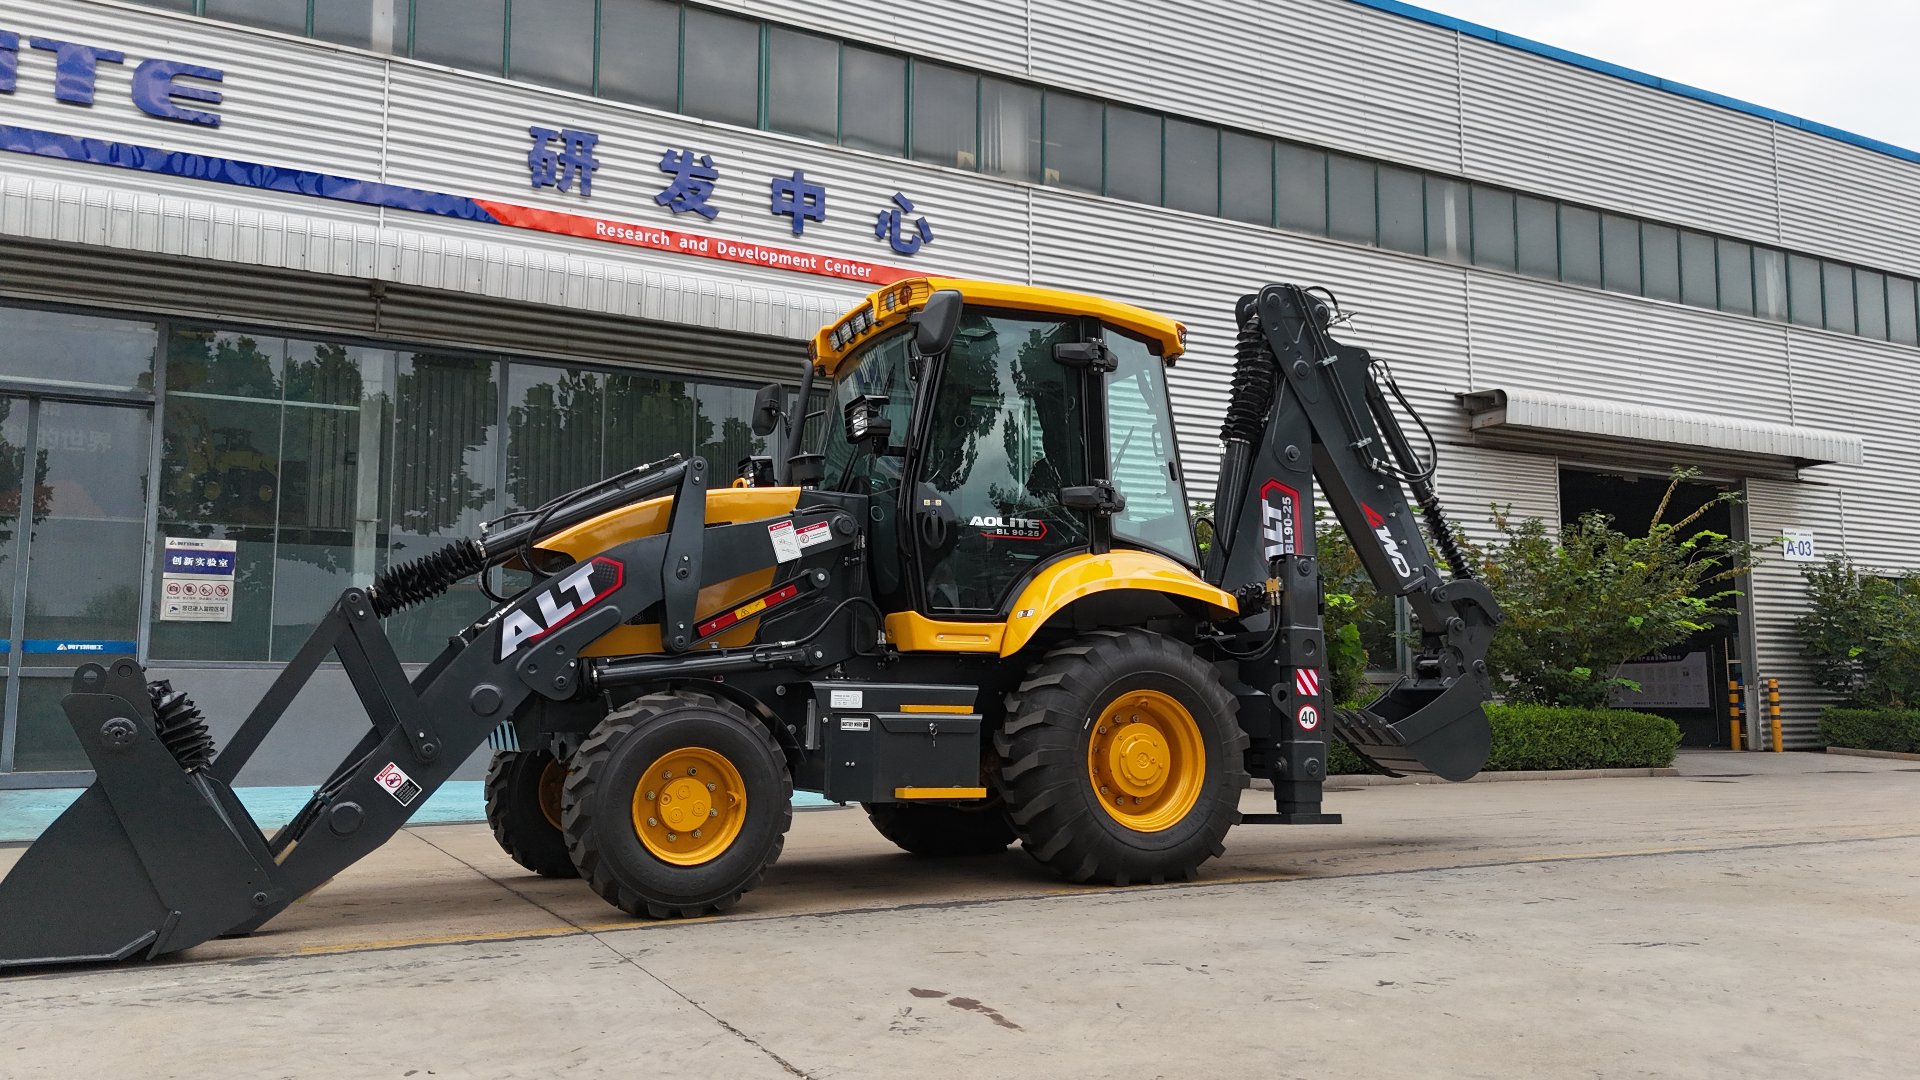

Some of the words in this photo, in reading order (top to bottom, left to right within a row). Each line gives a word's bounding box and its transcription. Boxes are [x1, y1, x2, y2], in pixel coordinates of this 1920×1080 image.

[528, 126, 935, 255] 研发中心
[595, 221, 670, 246] Research
[679, 238, 708, 252] and
[717, 241, 817, 269] Development
[824, 259, 872, 278] Center
[969, 515, 1040, 529] AOLITE
[1012, 529, 1040, 537] 90-25
[1282, 496, 1294, 554] BL90-25
[1360, 501, 1411, 578] 4WD
[172, 556, 229, 568] 创新实验室
[1786, 540, 1812, 557] A-03
[501, 562, 596, 661] ALT
[1300, 710, 1316, 725] 40
